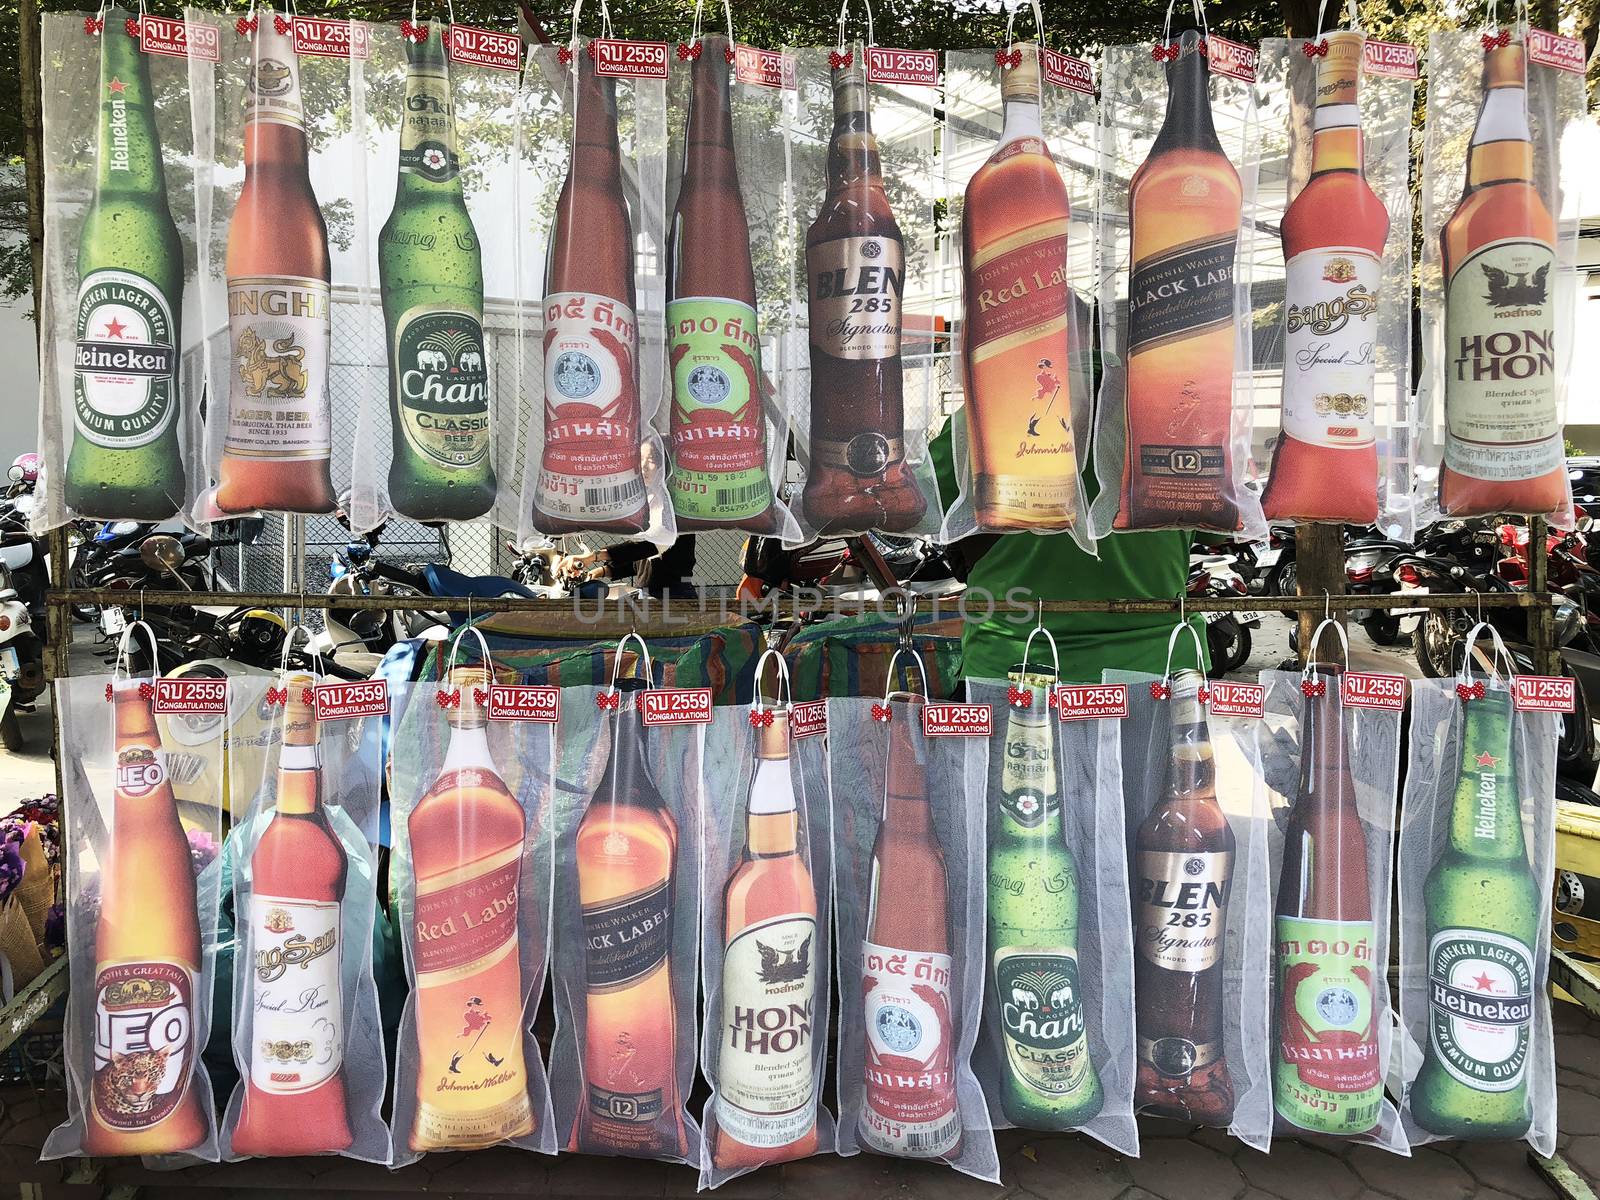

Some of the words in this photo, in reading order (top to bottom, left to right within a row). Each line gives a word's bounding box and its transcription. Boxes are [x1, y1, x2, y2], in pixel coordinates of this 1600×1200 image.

[175, 27, 215, 45] 2559
[325, 25, 364, 44] 2559
[480, 36, 517, 55] 2559
[626, 46, 664, 63] 2559
[897, 54, 933, 71] 2559
[1064, 59, 1089, 80] 2559
[110, 99, 129, 171] Heineken
[1139, 267, 1184, 288] JOHNNIE
[1186, 256, 1225, 270] WALKER
[977, 277, 1031, 313] Red
[1130, 279, 1188, 312] BLACK
[80, 288, 108, 331] HEINEKEN
[113, 288, 149, 310] LAGER
[148, 307, 165, 336] BEER
[229, 290, 329, 320] INGHA
[849, 298, 891, 313] 285
[76, 347, 167, 370] Heineken
[1295, 342, 1349, 371] Special
[1485, 389, 1526, 398] Blended
[76, 389, 114, 431] PREMIUM
[122, 394, 164, 431] QUALITY
[276, 411, 309, 421] BEER
[1176, 455, 1196, 469] 12
[186, 684, 224, 699] 2559
[346, 686, 383, 703] 2559
[1086, 689, 1123, 704] 2559
[1232, 688, 1260, 704] 2559
[1369, 680, 1402, 696] 2559
[1539, 681, 1571, 697] 2559
[519, 692, 555, 707] 2559
[672, 694, 707, 709] 2559
[952, 709, 988, 723] 2559
[117, 763, 163, 788] LEO
[1474, 772, 1496, 839] Heineken
[417, 917, 458, 942] Red
[462, 884, 518, 930] Label
[611, 908, 649, 926] WALKER
[1166, 912, 1211, 927] 285
[619, 908, 671, 943] LABEL
[133, 967, 163, 976] GREAT
[1437, 944, 1475, 974] HEINEKEN
[1481, 946, 1516, 966] LAGER
[1515, 962, 1528, 987] BEER
[1434, 985, 1529, 1021] Heineken
[95, 1002, 190, 1064] LEO
[1015, 1039, 1085, 1065] CLASSIC
[1438, 1025, 1486, 1076] PREMIUM
[1493, 1039, 1527, 1077] QUALITY
[755, 1062, 791, 1072] Blended
[615, 1101, 632, 1115] 12
